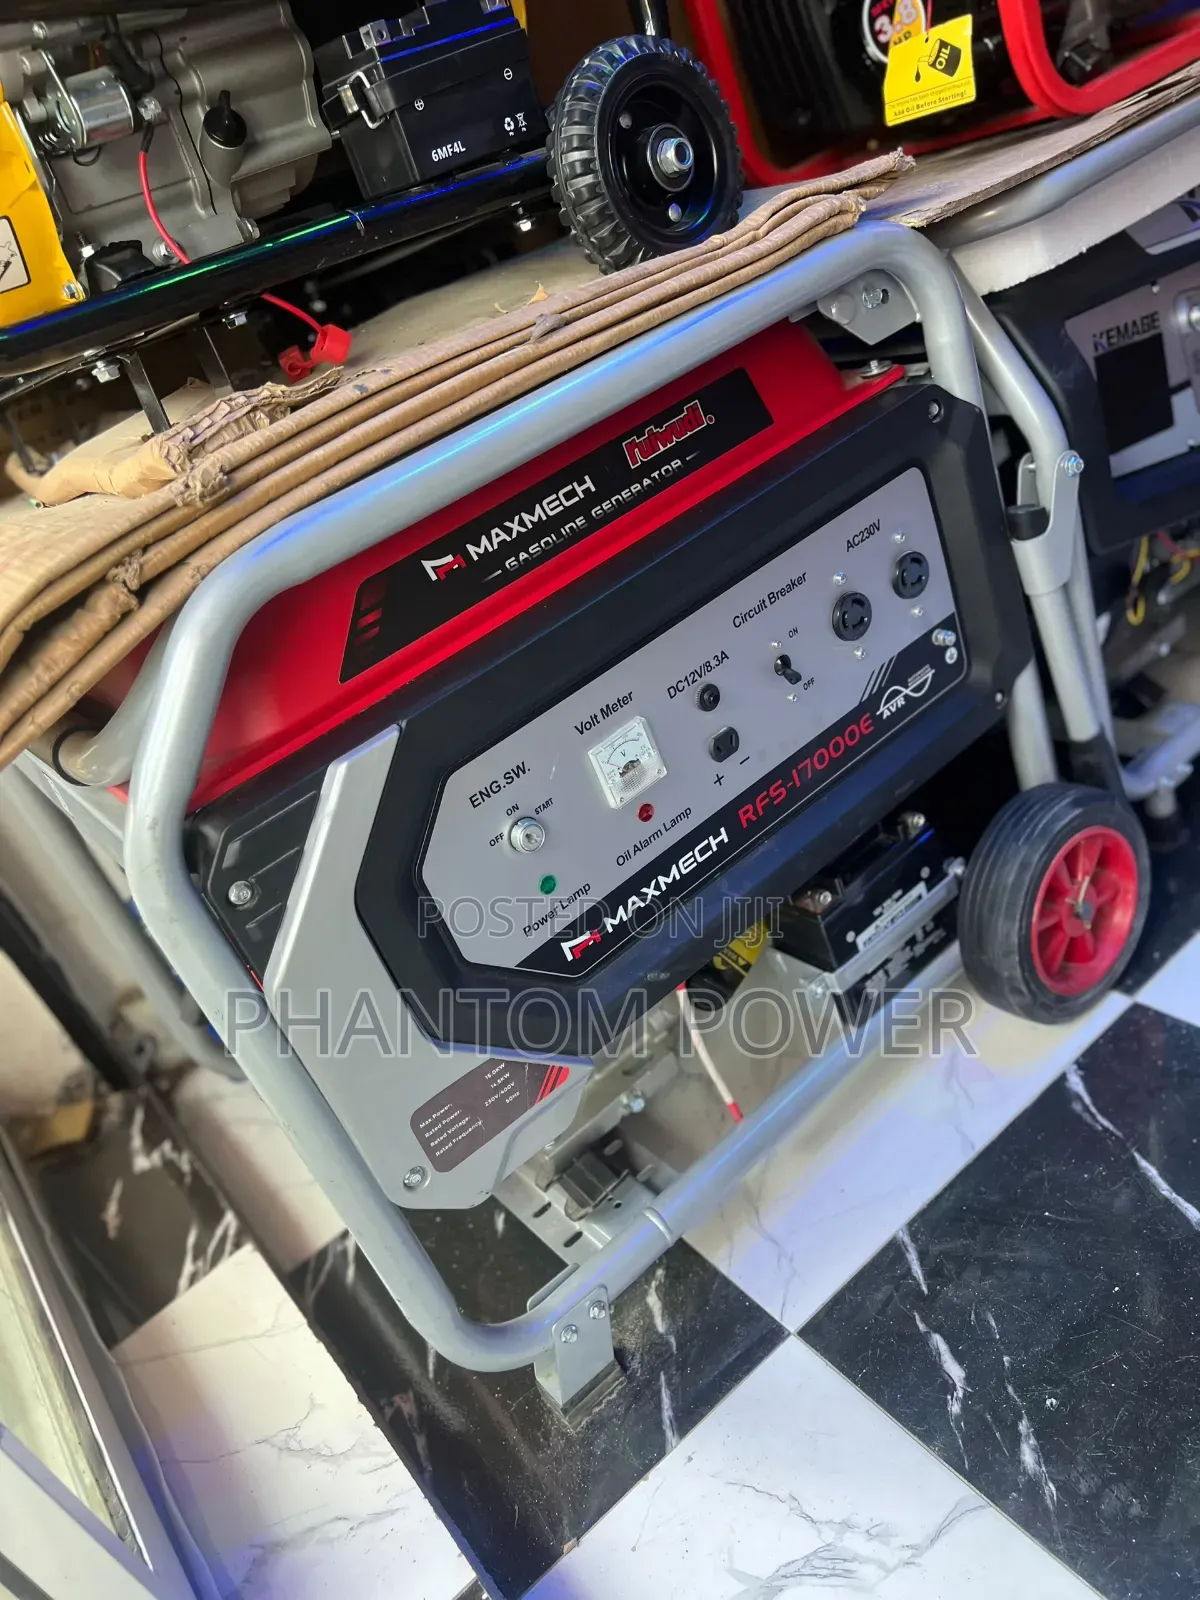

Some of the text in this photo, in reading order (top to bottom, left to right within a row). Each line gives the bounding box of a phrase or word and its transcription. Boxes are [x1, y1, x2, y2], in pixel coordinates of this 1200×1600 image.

[935, 45, 951, 70] OIL
[906, 105, 915, 113] Oil
[916, 100, 937, 110] Before
[938, 90, 968, 103] Starting!
[431, 140, 466, 162] 6MF4L
[465, 474, 597, 561] MAXMECH
[504, 458, 683, 572] GASOLINE GENERATOR
[845, 518, 882, 553] AC230V
[731, 571, 808, 629] Circuit Breaker
[788, 627, 799, 639] ON
[667, 649, 730, 700] DC12V/8.3A
[803, 677, 816, 691] OFF
[574, 691, 635, 737] Volt Meter
[882, 696, 906, 719] AVR
[468, 761, 531, 809] ENG.SW.
[505, 803, 520, 818] ON
[534, 797, 555, 816] START
[603, 826, 730, 934] MAXMECH
[737, 712, 875, 829] RFS-17000E
[489, 832, 506, 848] OFF
[616, 805, 693, 868] Oil Alarm Lamp
[522, 882, 592, 938] Power Lamp
[484, 1062, 506, 1080] 15.0KW
[424, 1123, 442, 1138] Rated
[490, 1071, 510, 1089] 14.5KW
[430, 1132, 448, 1147] Rated
[435, 1141, 453, 1157] Rated
